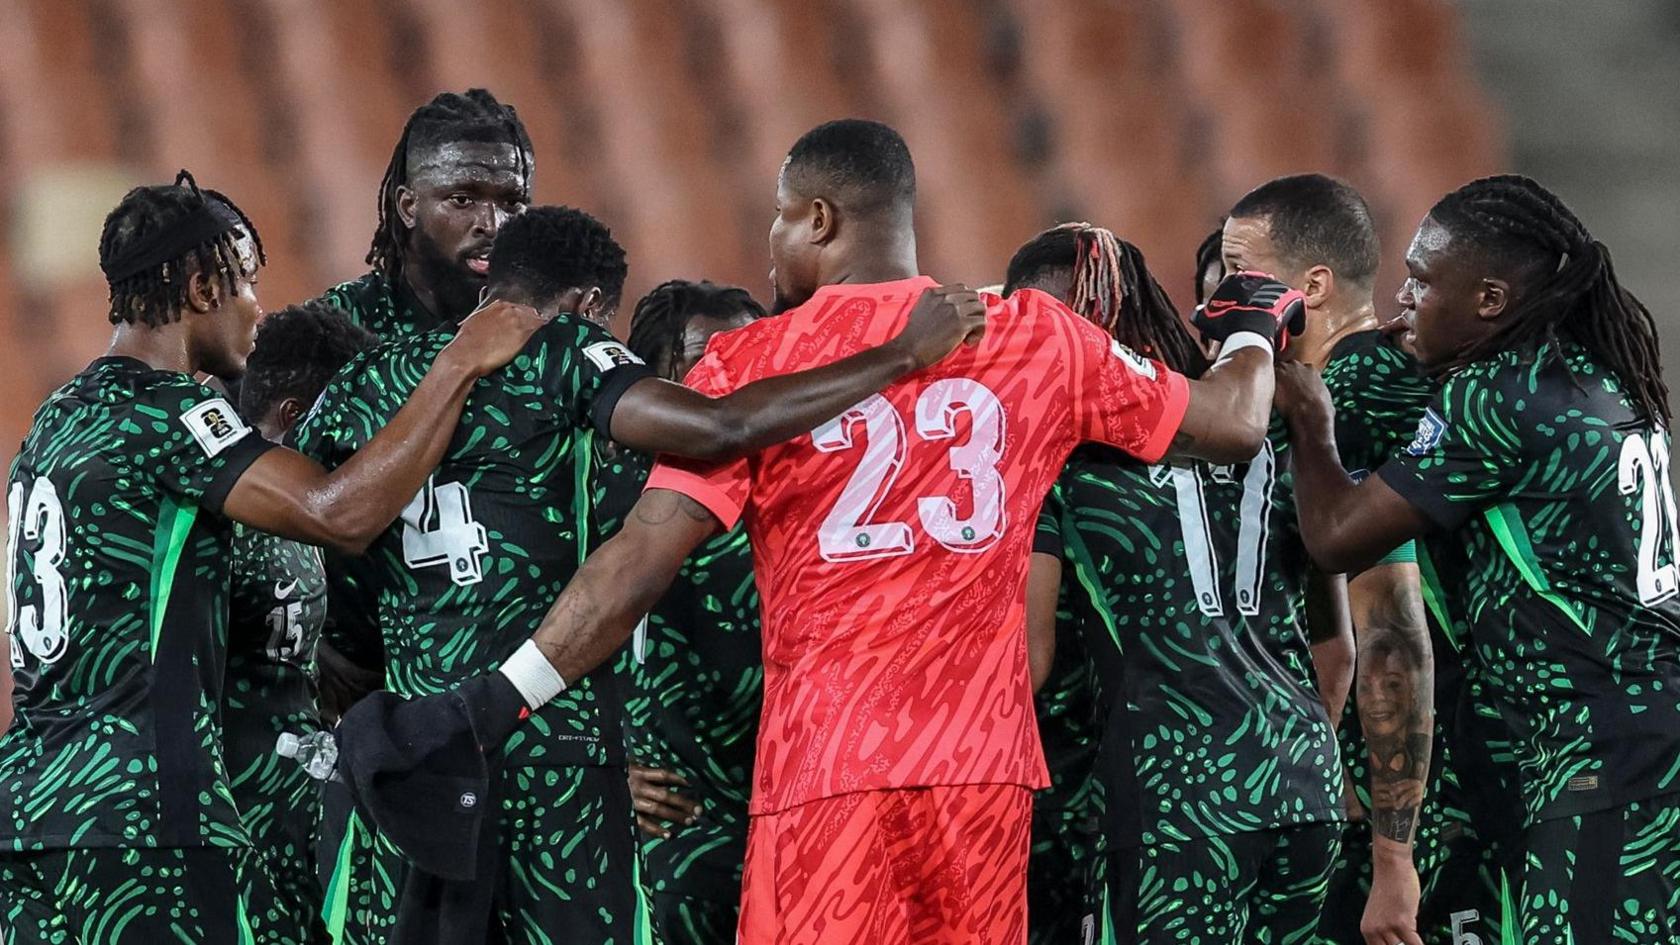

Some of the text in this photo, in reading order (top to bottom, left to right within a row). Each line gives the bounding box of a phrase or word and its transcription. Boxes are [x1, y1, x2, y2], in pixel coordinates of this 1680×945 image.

[400, 473, 489, 587] 4
[811, 378, 1006, 562] 23
[1148, 437, 1275, 617] 17
[5, 476, 69, 668] 13
[265, 601, 303, 662] 15
